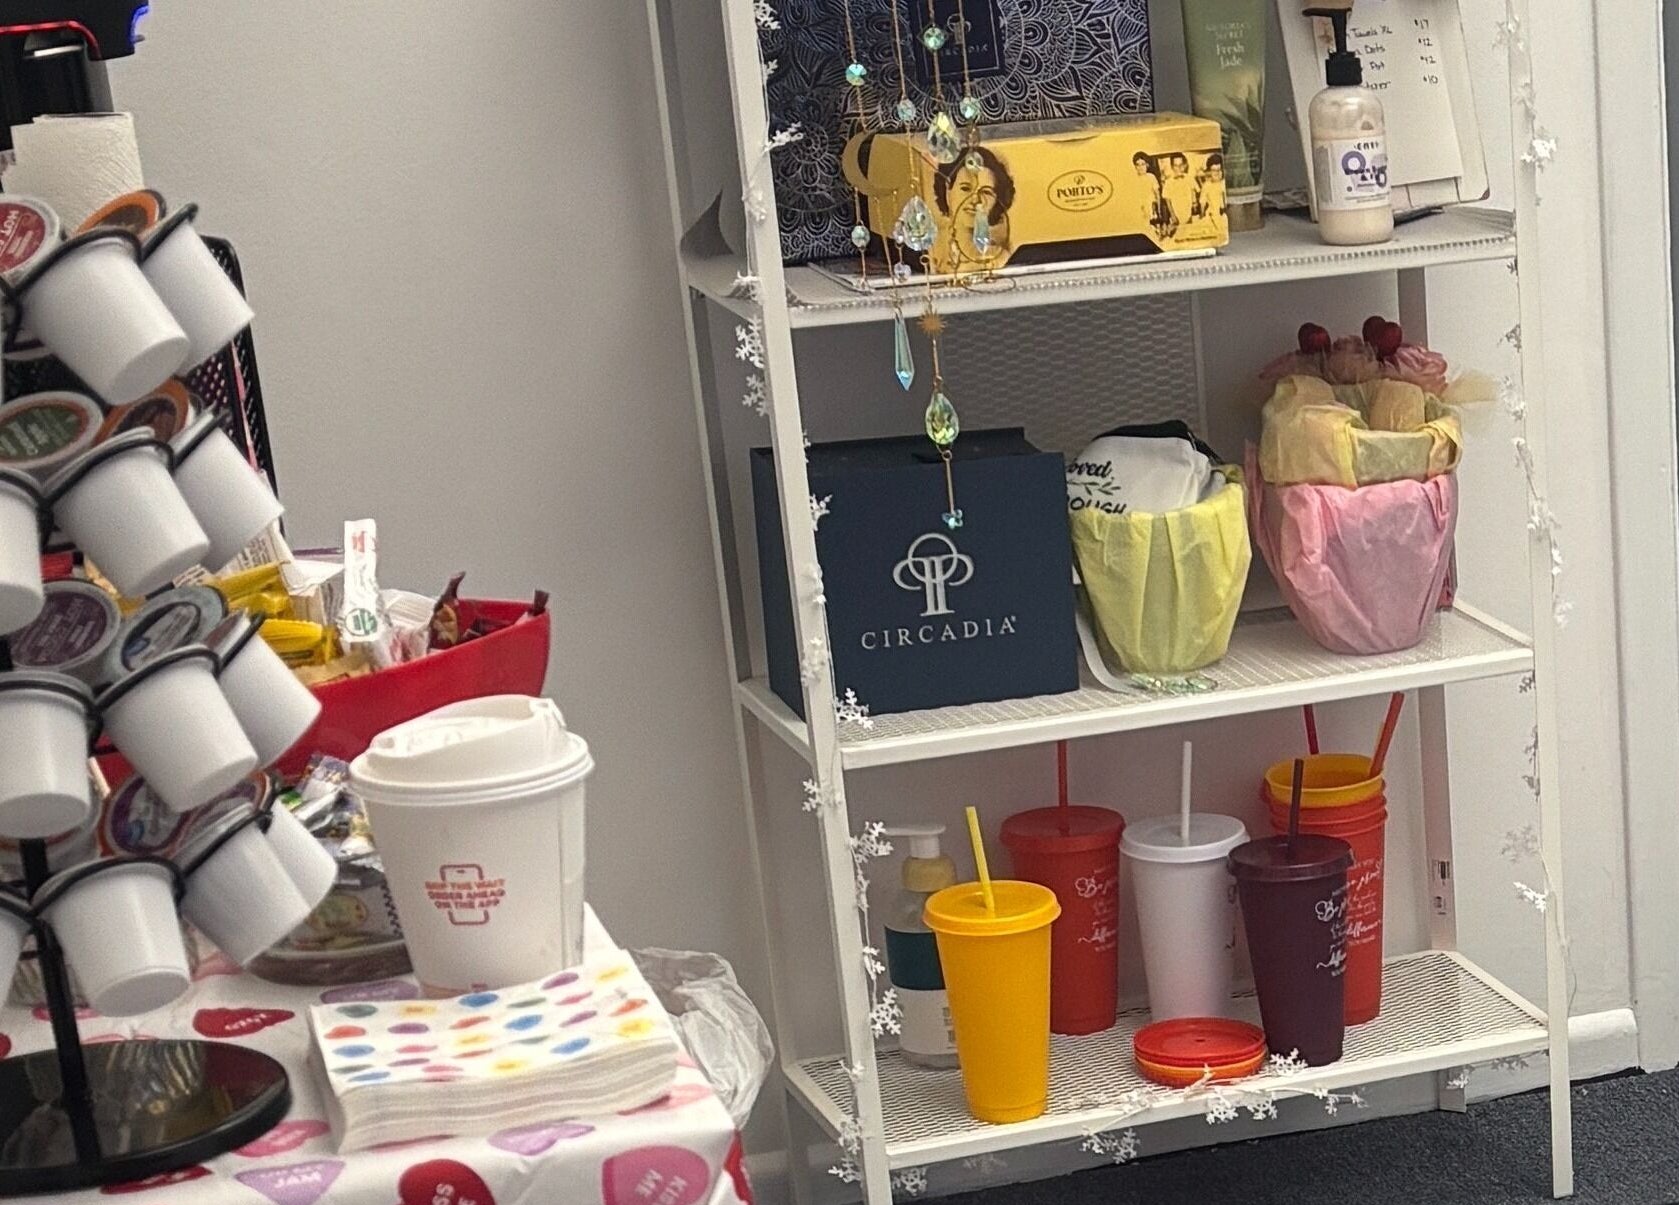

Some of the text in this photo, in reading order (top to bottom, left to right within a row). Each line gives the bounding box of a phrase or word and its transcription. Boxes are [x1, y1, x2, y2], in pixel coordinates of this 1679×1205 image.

[1056, 184, 1105, 199] PORTO'S
[1067, 457, 1113, 478] oved
[861, 616, 1016, 650] CIRCADIA
[272, 1170, 323, 1188] JAM
